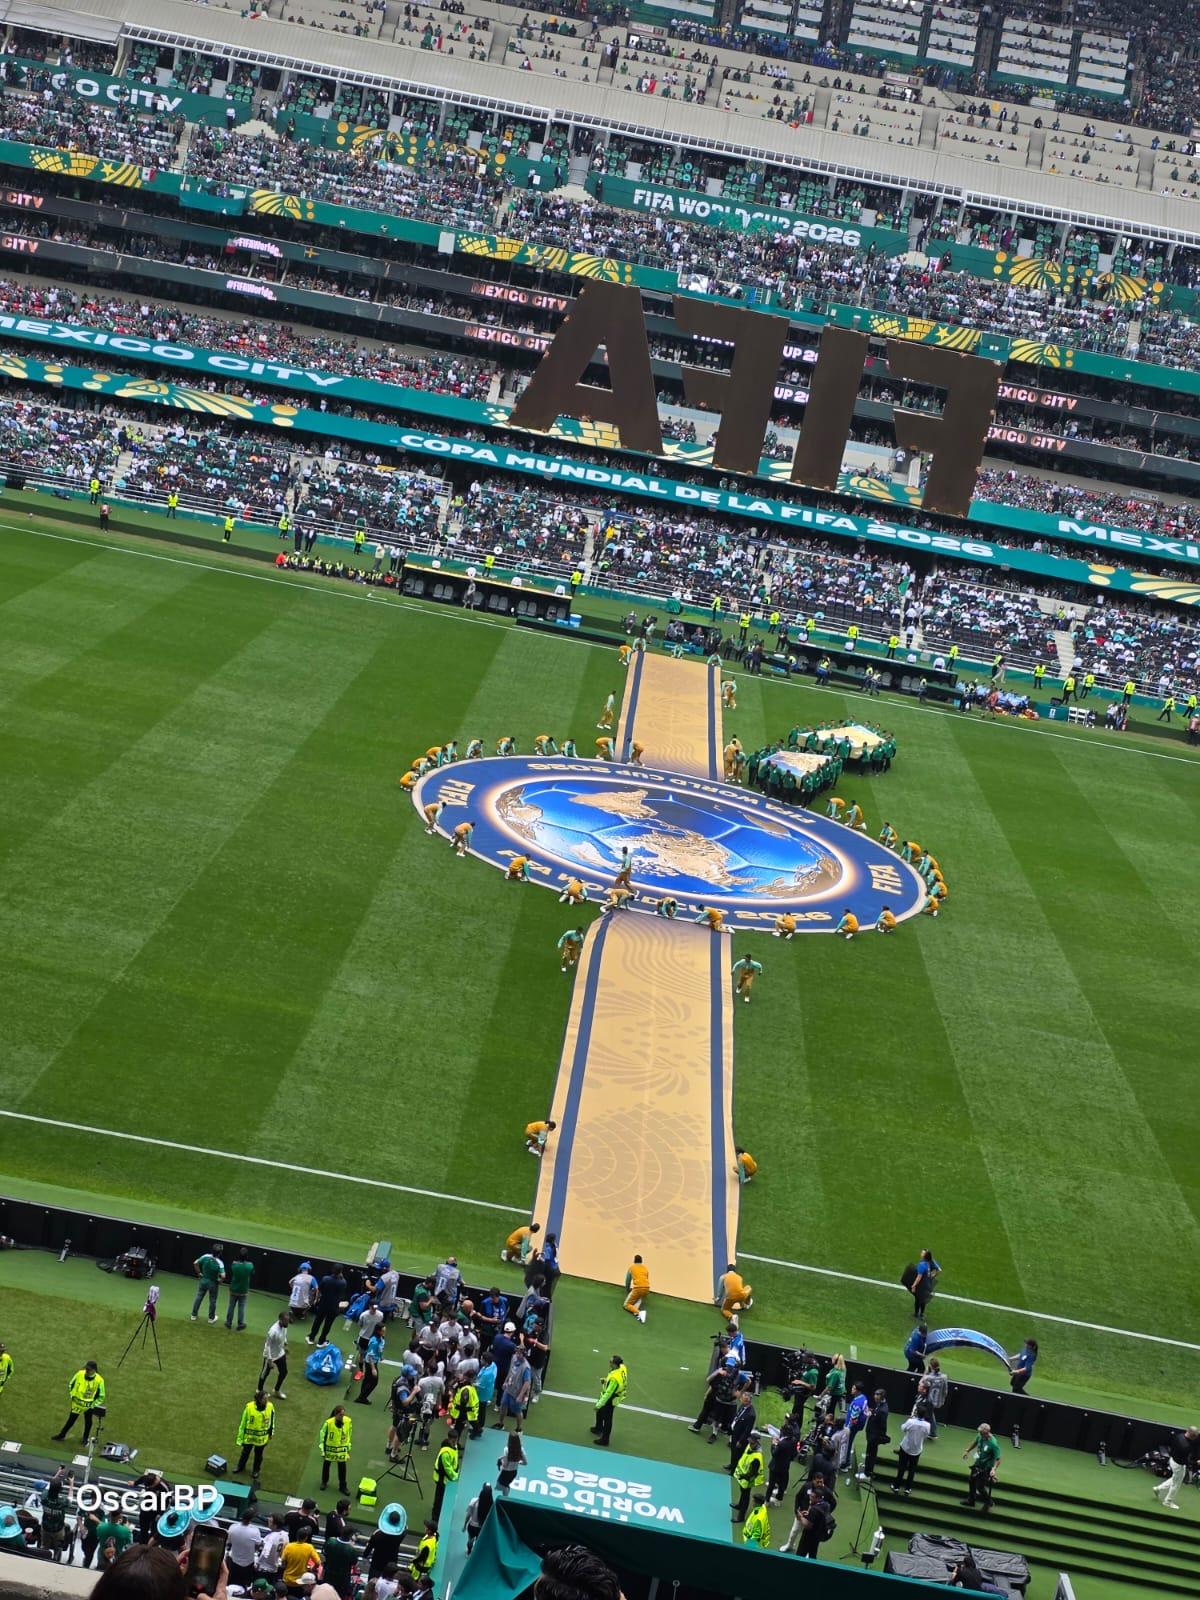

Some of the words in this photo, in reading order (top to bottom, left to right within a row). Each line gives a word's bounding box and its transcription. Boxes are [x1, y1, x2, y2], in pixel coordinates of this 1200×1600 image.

[7, 192, 44, 208] CITY
[633, 188, 674, 211] FIFA
[793, 220, 861, 247] 2026
[2, 236, 39, 253] CITY
[471, 282, 529, 304] MEXICO
[532, 296, 567, 311] CITY
[464, 326, 521, 346] MEXICO
[524, 337, 553, 352] CIT
[208, 355, 344, 387] CITY
[1040, 394, 1078, 410] CITY
[1031, 436, 1067, 451] CITY
[400, 434, 498, 462] COPA
[505, 453, 667, 494] MUNDIAL
[675, 486, 721, 505] DE
[728, 496, 773, 515] LA
[781, 507, 858, 531] FIFA
[867, 523, 994, 558] 2026
[438, 779, 476, 806] FIFA
[669, 778, 759, 804] WORLD
[867, 864, 902, 896] FIFA
[509, 1477, 569, 1499] CUP
[546, 1466, 652, 1499] 2026
[573, 1489, 685, 1524] WORLD
